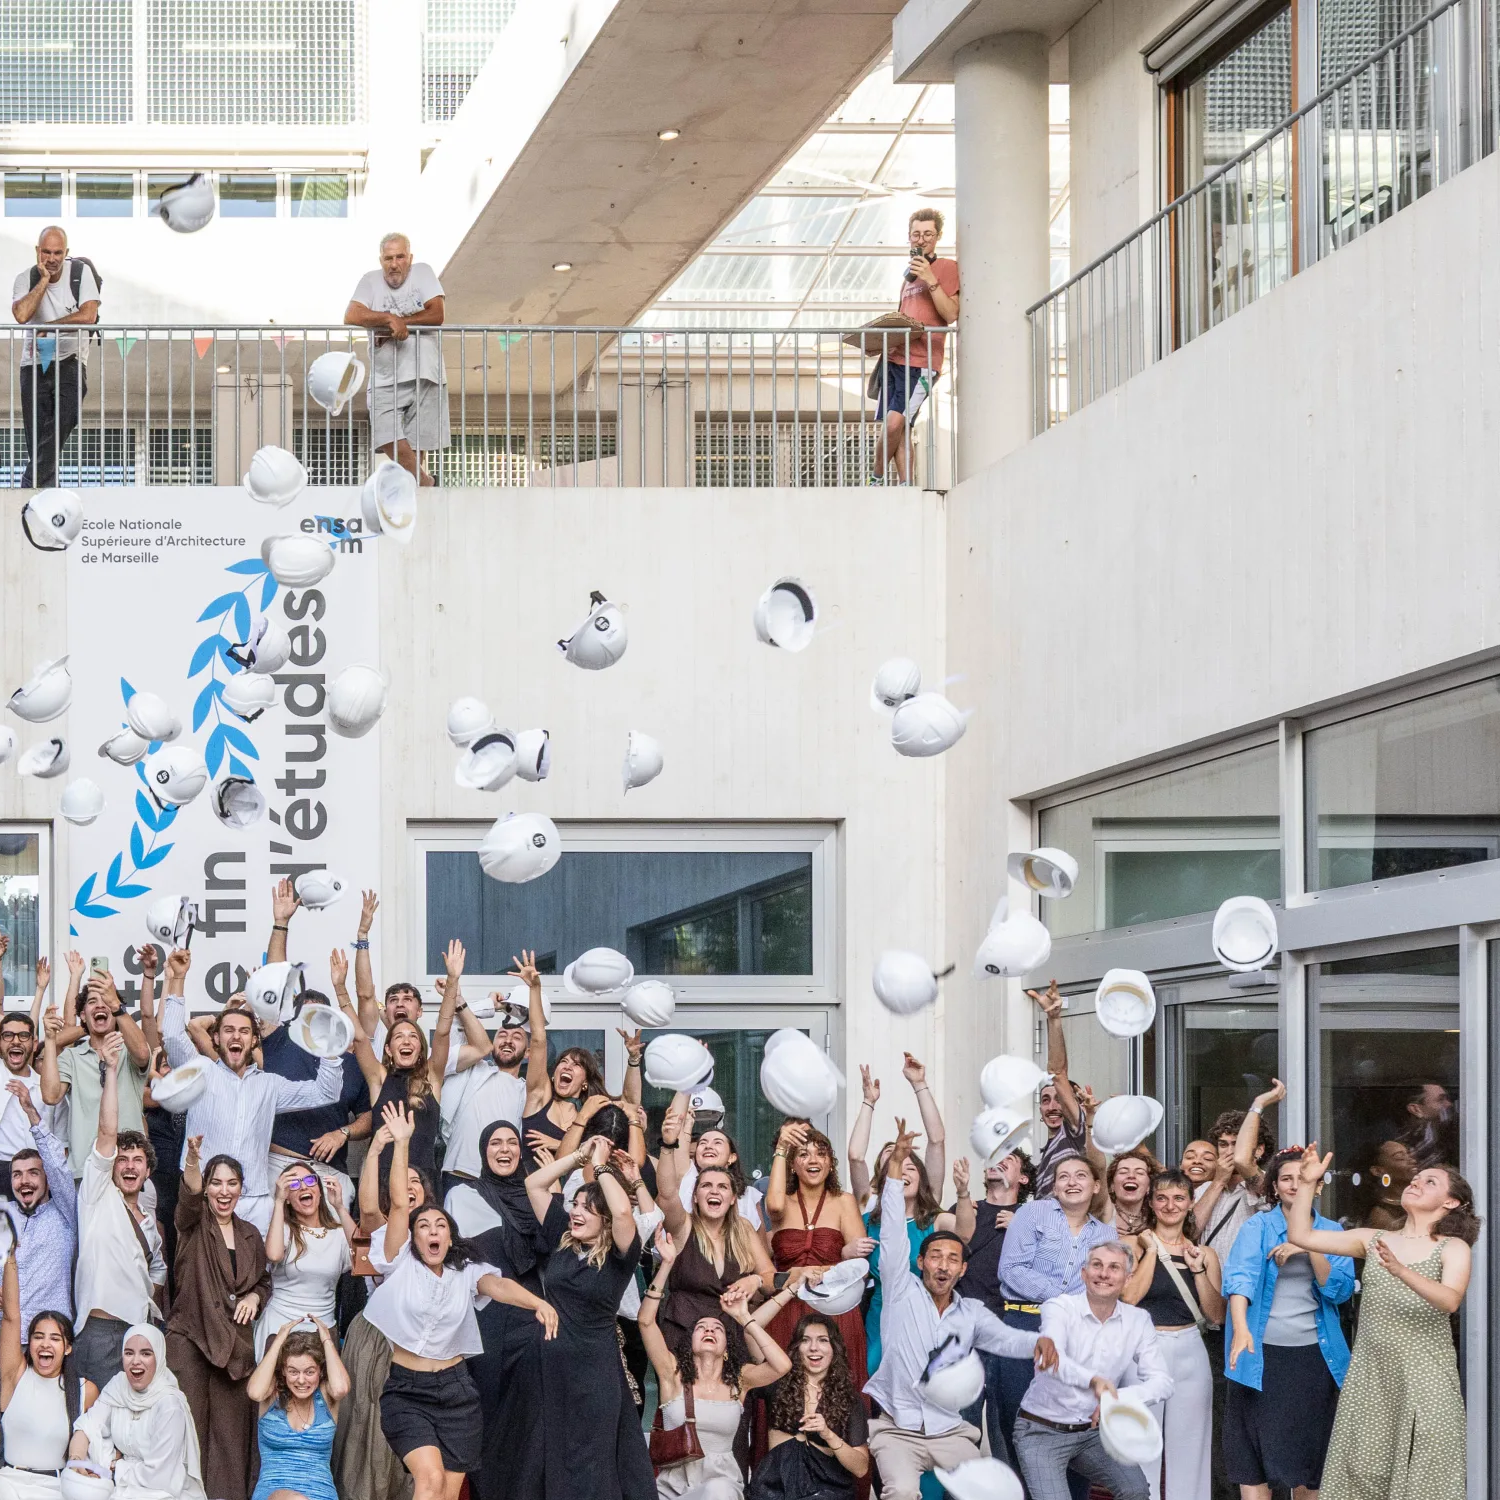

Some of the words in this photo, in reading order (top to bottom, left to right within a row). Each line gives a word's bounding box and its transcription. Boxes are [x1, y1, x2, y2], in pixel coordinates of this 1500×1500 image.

[119, 518, 182, 530] Nationale
[300, 517, 363, 534] ensa
[81, 535, 151, 549] Supérieure
[155, 535, 246, 547] d'Architecture
[81, 552, 98, 564] de
[102, 552, 159, 564] Marseille
[269, 588, 328, 907] d'études
[189, 851, 246, 938] fin
